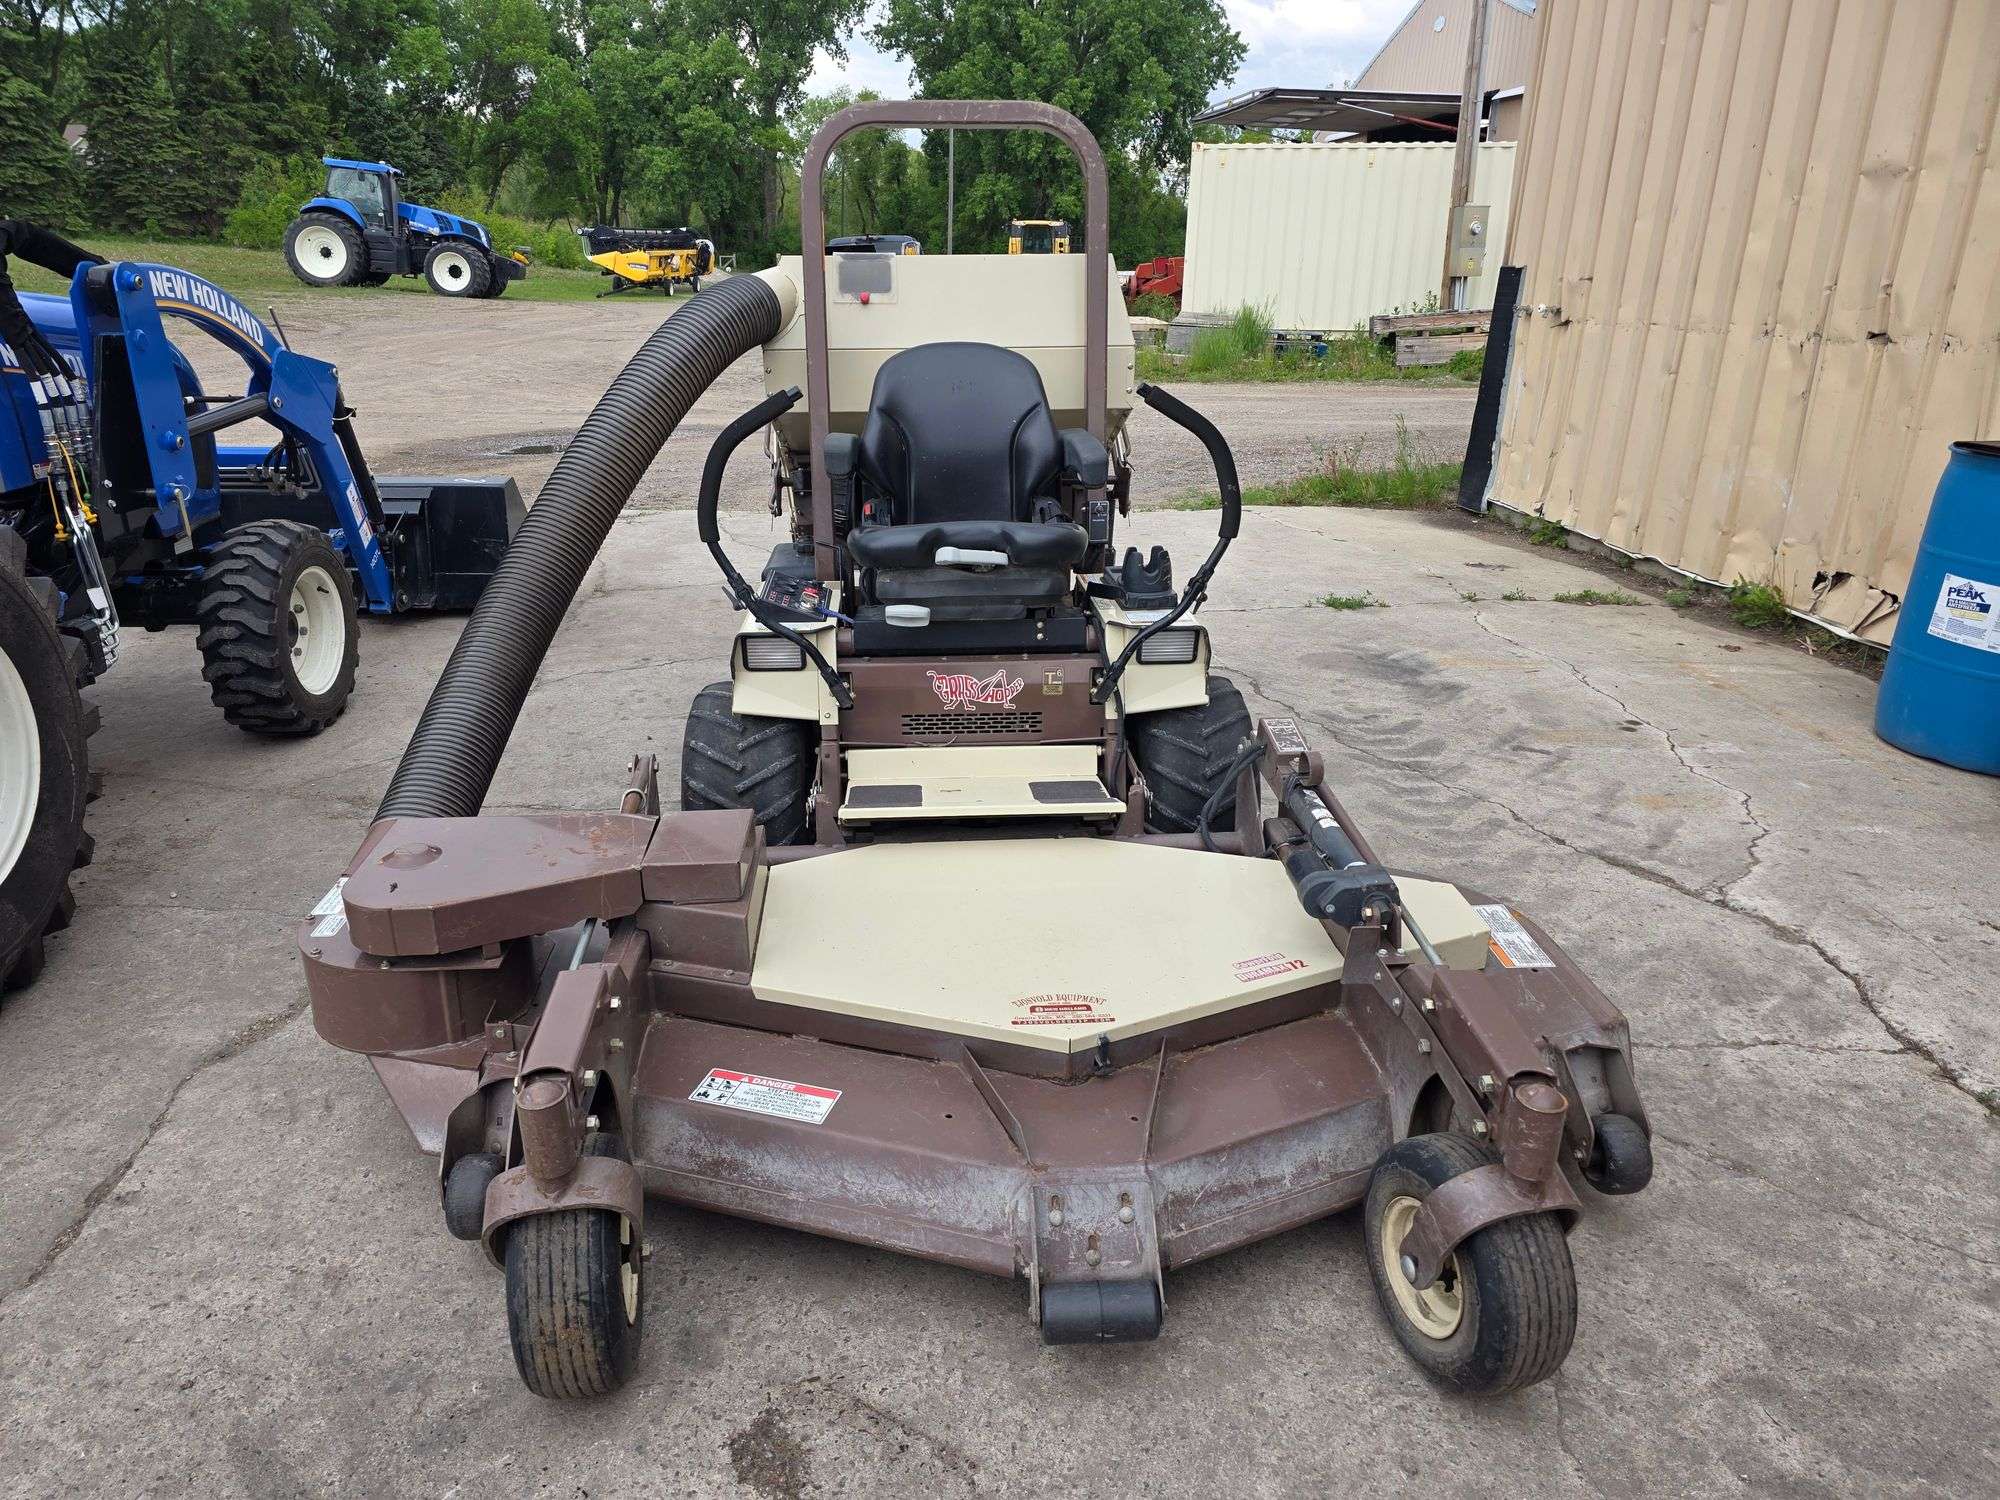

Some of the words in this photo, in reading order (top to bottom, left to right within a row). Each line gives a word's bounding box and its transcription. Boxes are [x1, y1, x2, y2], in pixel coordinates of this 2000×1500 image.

[148, 270, 189, 300] NEW
[189, 278, 264, 347] HOLLAND
[1947, 586, 1986, 603] PEAK
[1286, 959, 1310, 970] 72
[1056, 993, 1107, 1006] EQUIPMENT
[752, 1078, 796, 1090] DANGER
